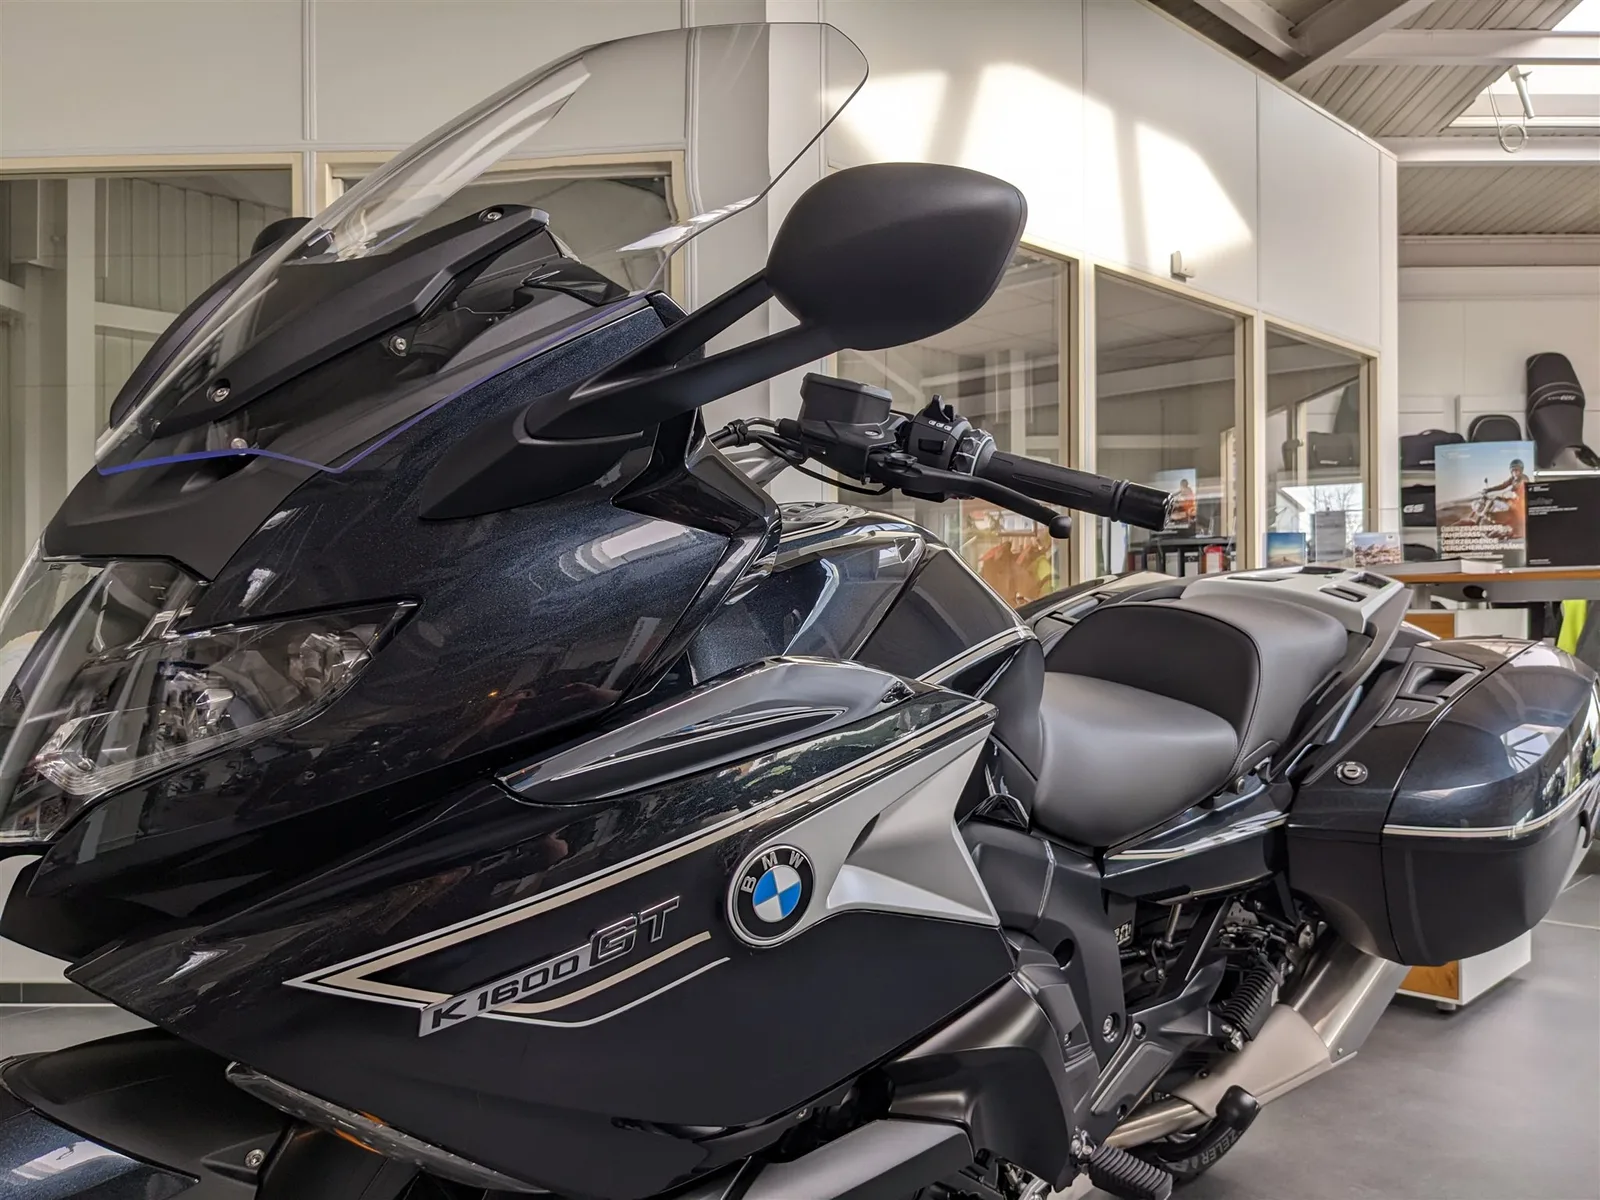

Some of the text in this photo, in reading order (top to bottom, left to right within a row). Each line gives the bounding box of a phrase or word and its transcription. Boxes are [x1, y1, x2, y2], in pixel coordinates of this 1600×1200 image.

[1403, 503, 1425, 513] GS
[741, 849, 803, 894] BMW
[431, 895, 680, 1029] K 1600 GT
[1201, 1128, 1239, 1165] ZELER
